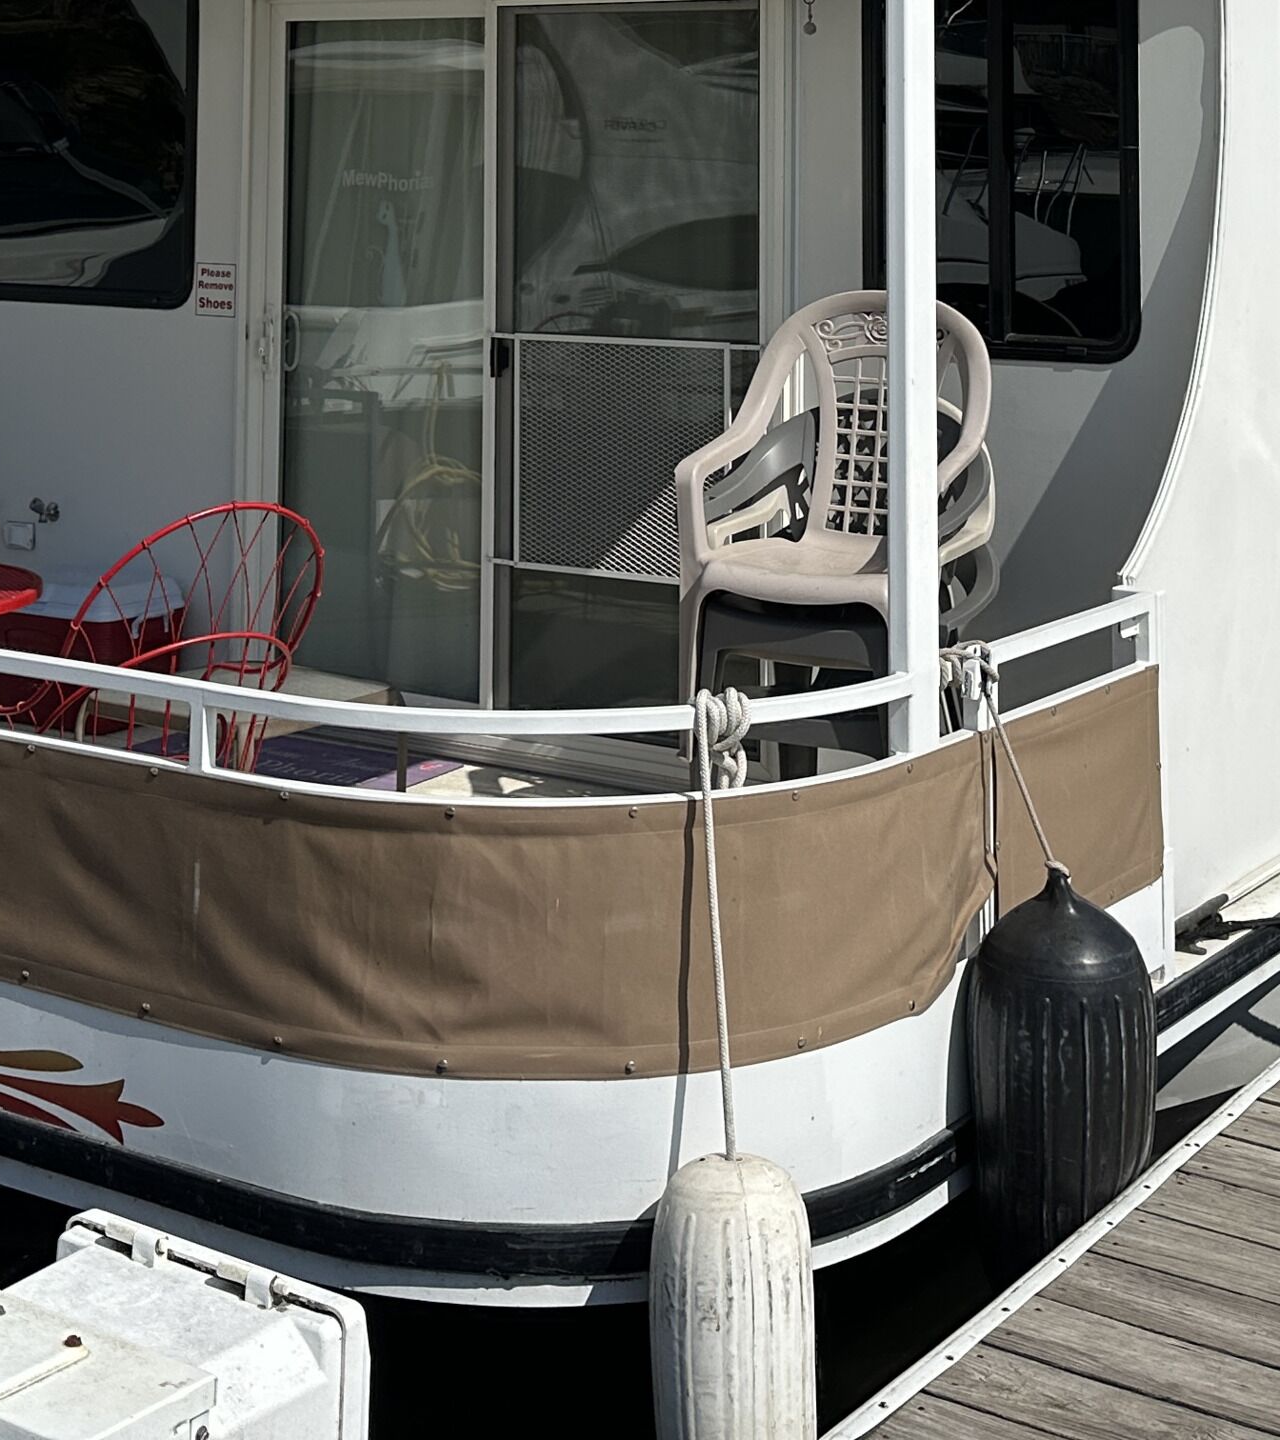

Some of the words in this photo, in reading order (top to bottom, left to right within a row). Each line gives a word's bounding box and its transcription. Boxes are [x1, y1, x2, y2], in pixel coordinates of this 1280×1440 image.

[342, 169, 433, 192] MewPhoria
[201, 268, 231, 278] Please
[198, 280, 234, 291] Remove
[199, 296, 232, 310] Shoes
